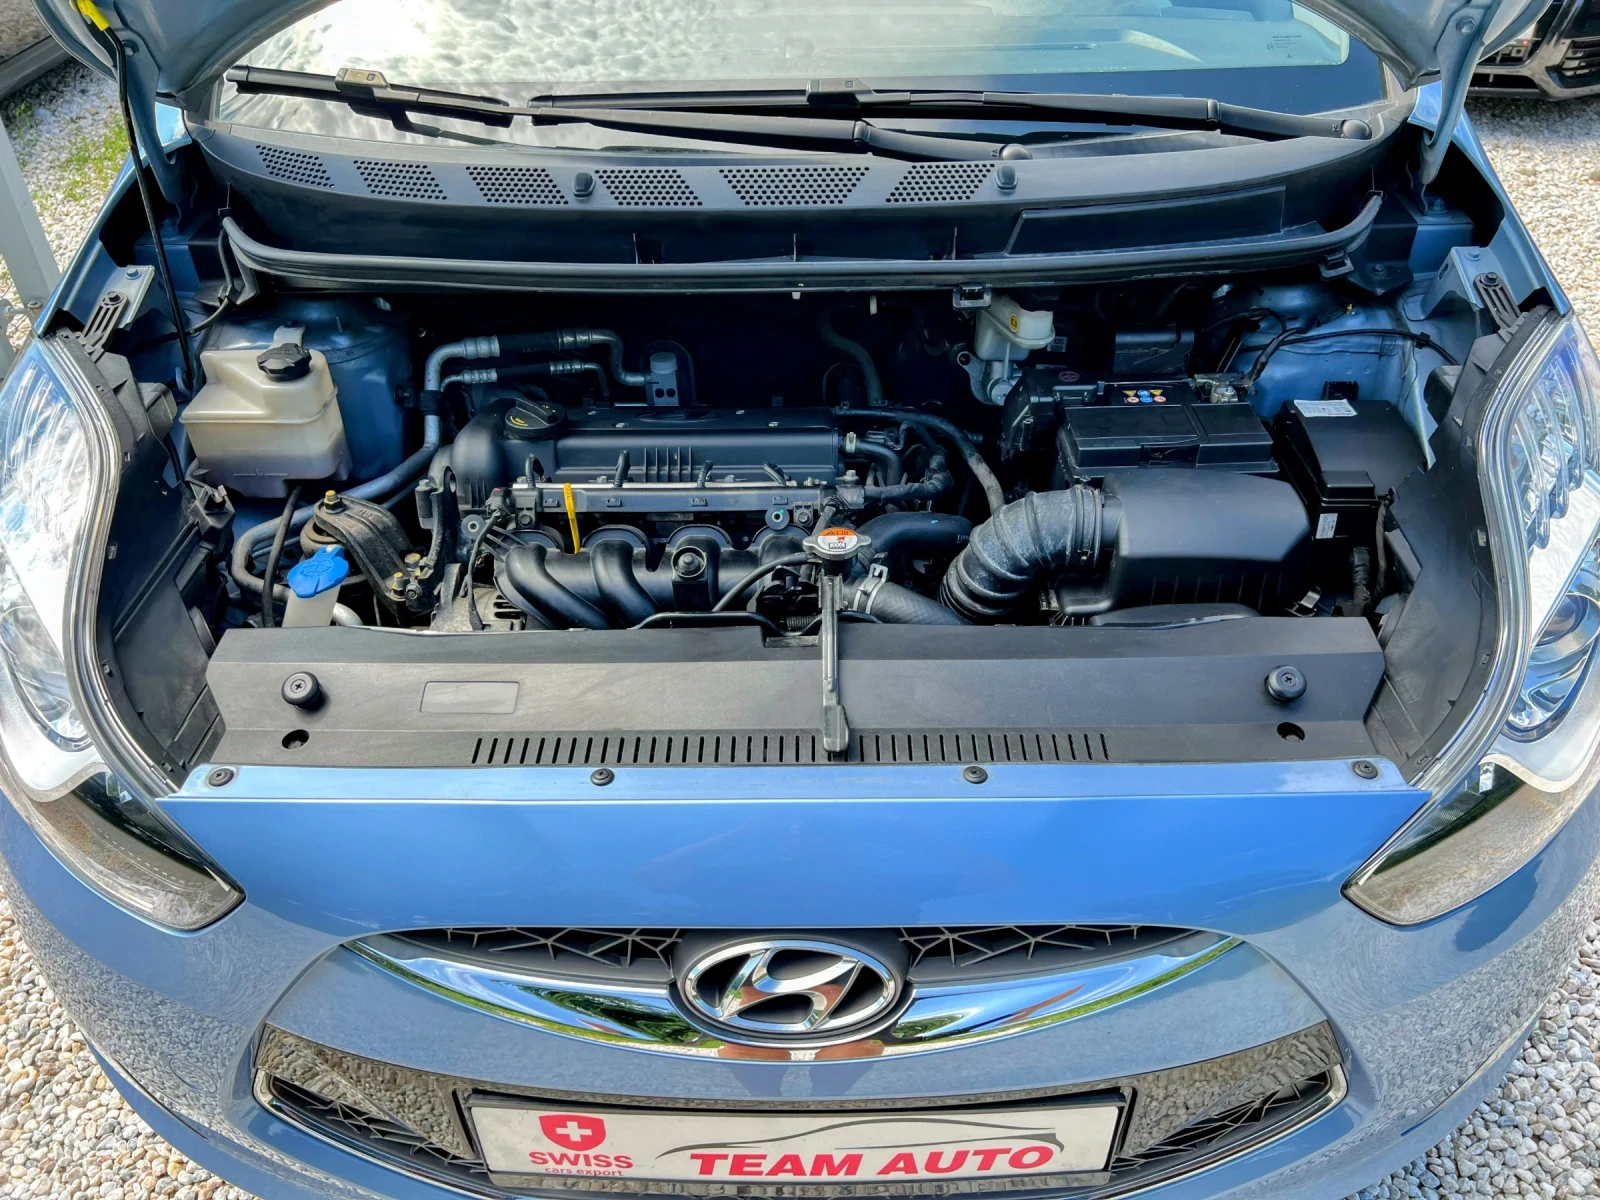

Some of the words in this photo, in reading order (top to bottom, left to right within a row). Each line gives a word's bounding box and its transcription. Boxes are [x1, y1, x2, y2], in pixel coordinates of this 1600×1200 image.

[529, 1152, 633, 1168] SWISS
[690, 1154, 863, 1176] TEAM
[876, 1146, 1054, 1175] AUTO
[576, 1169, 624, 1177] export
